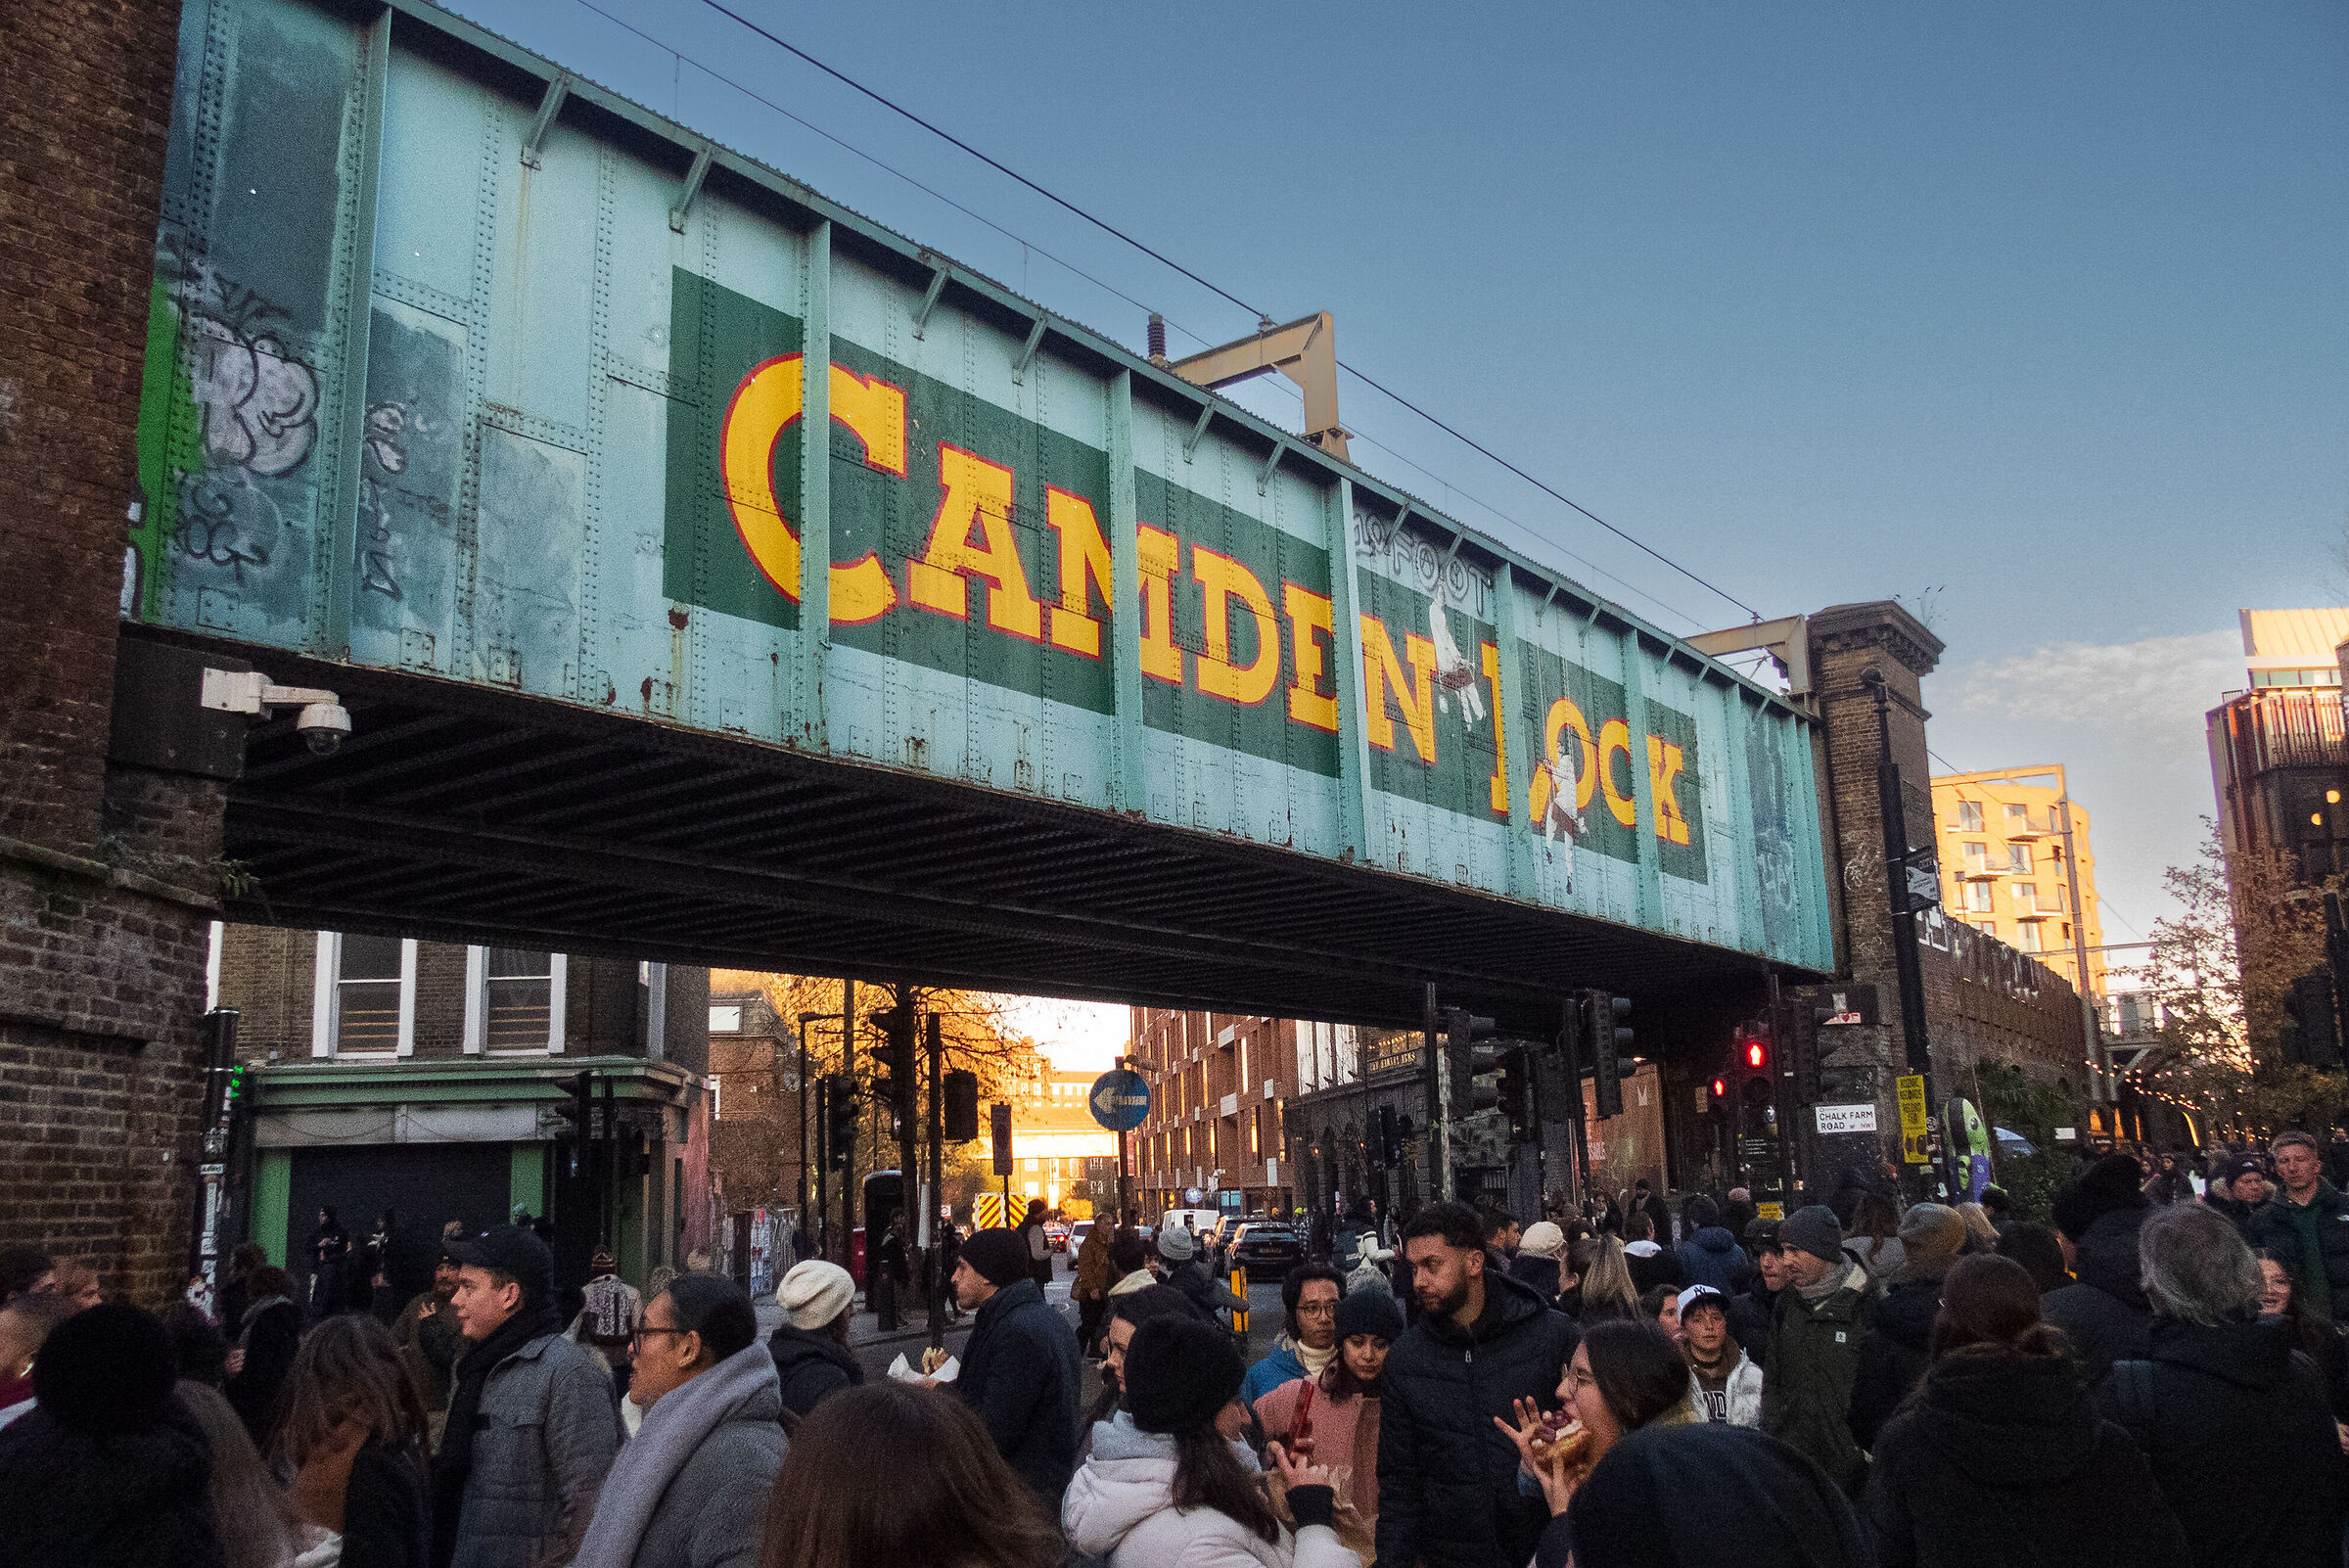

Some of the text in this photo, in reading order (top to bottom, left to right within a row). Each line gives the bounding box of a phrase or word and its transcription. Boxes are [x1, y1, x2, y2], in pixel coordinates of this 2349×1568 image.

[719, 351, 1690, 849] CAMDEN LOCK
[1819, 1112, 1847, 1121] CHALK
